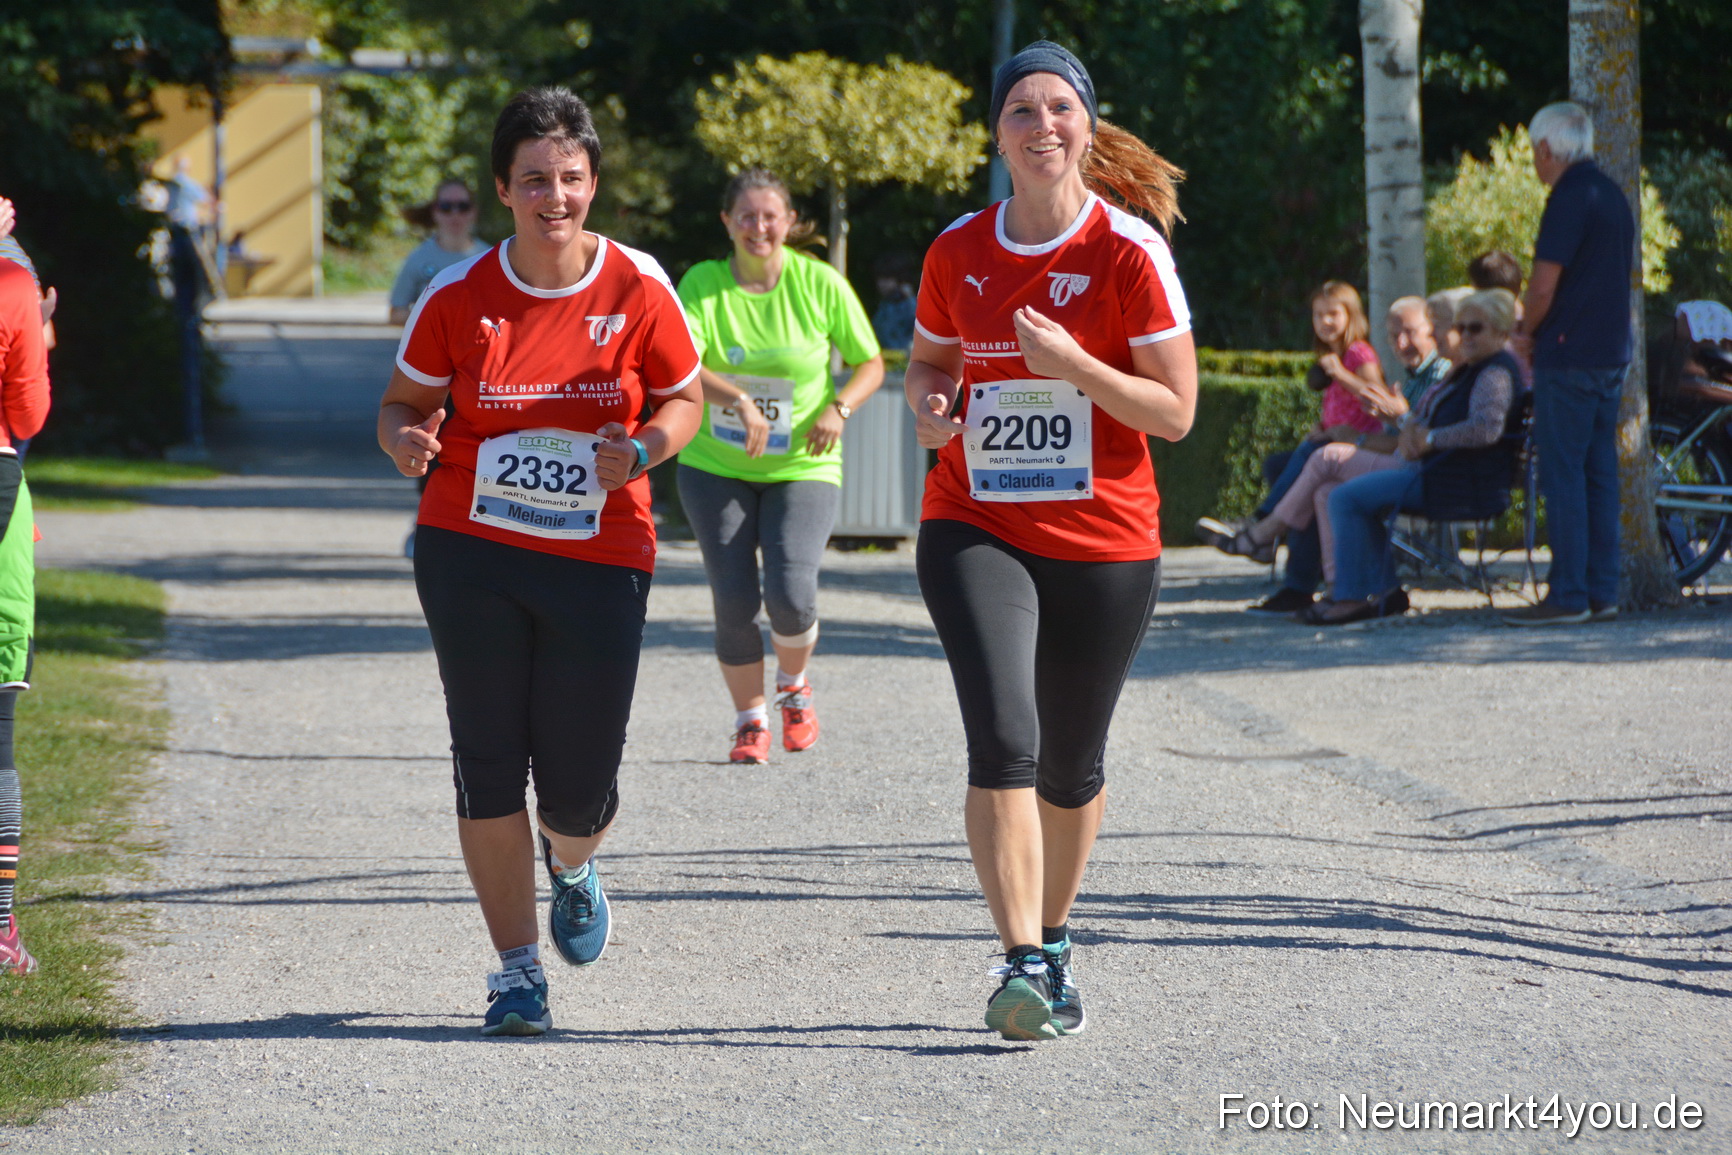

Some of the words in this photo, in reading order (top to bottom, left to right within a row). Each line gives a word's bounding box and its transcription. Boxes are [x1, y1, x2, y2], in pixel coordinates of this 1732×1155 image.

[478, 381, 559, 394] ENGELHARDT
[565, 384, 572, 392] &
[578, 377, 622, 392] WALTER
[582, 390, 622, 399] HERRENHAUS
[599, 395, 623, 407] Lauf
[998, 391, 1053, 405] BOCK
[477, 401, 522, 411] Amberg
[980, 414, 1072, 451] 2209
[518, 435, 573, 454] BOCK
[989, 457, 1014, 465] PARTL
[1016, 456, 1054, 464] Neumarkt
[495, 454, 588, 497] 2332
[998, 472, 1055, 489] Claudia
[502, 490, 528, 501] PARTL
[530, 496, 567, 507] Neumarkt
[507, 504, 566, 527] Melanie
